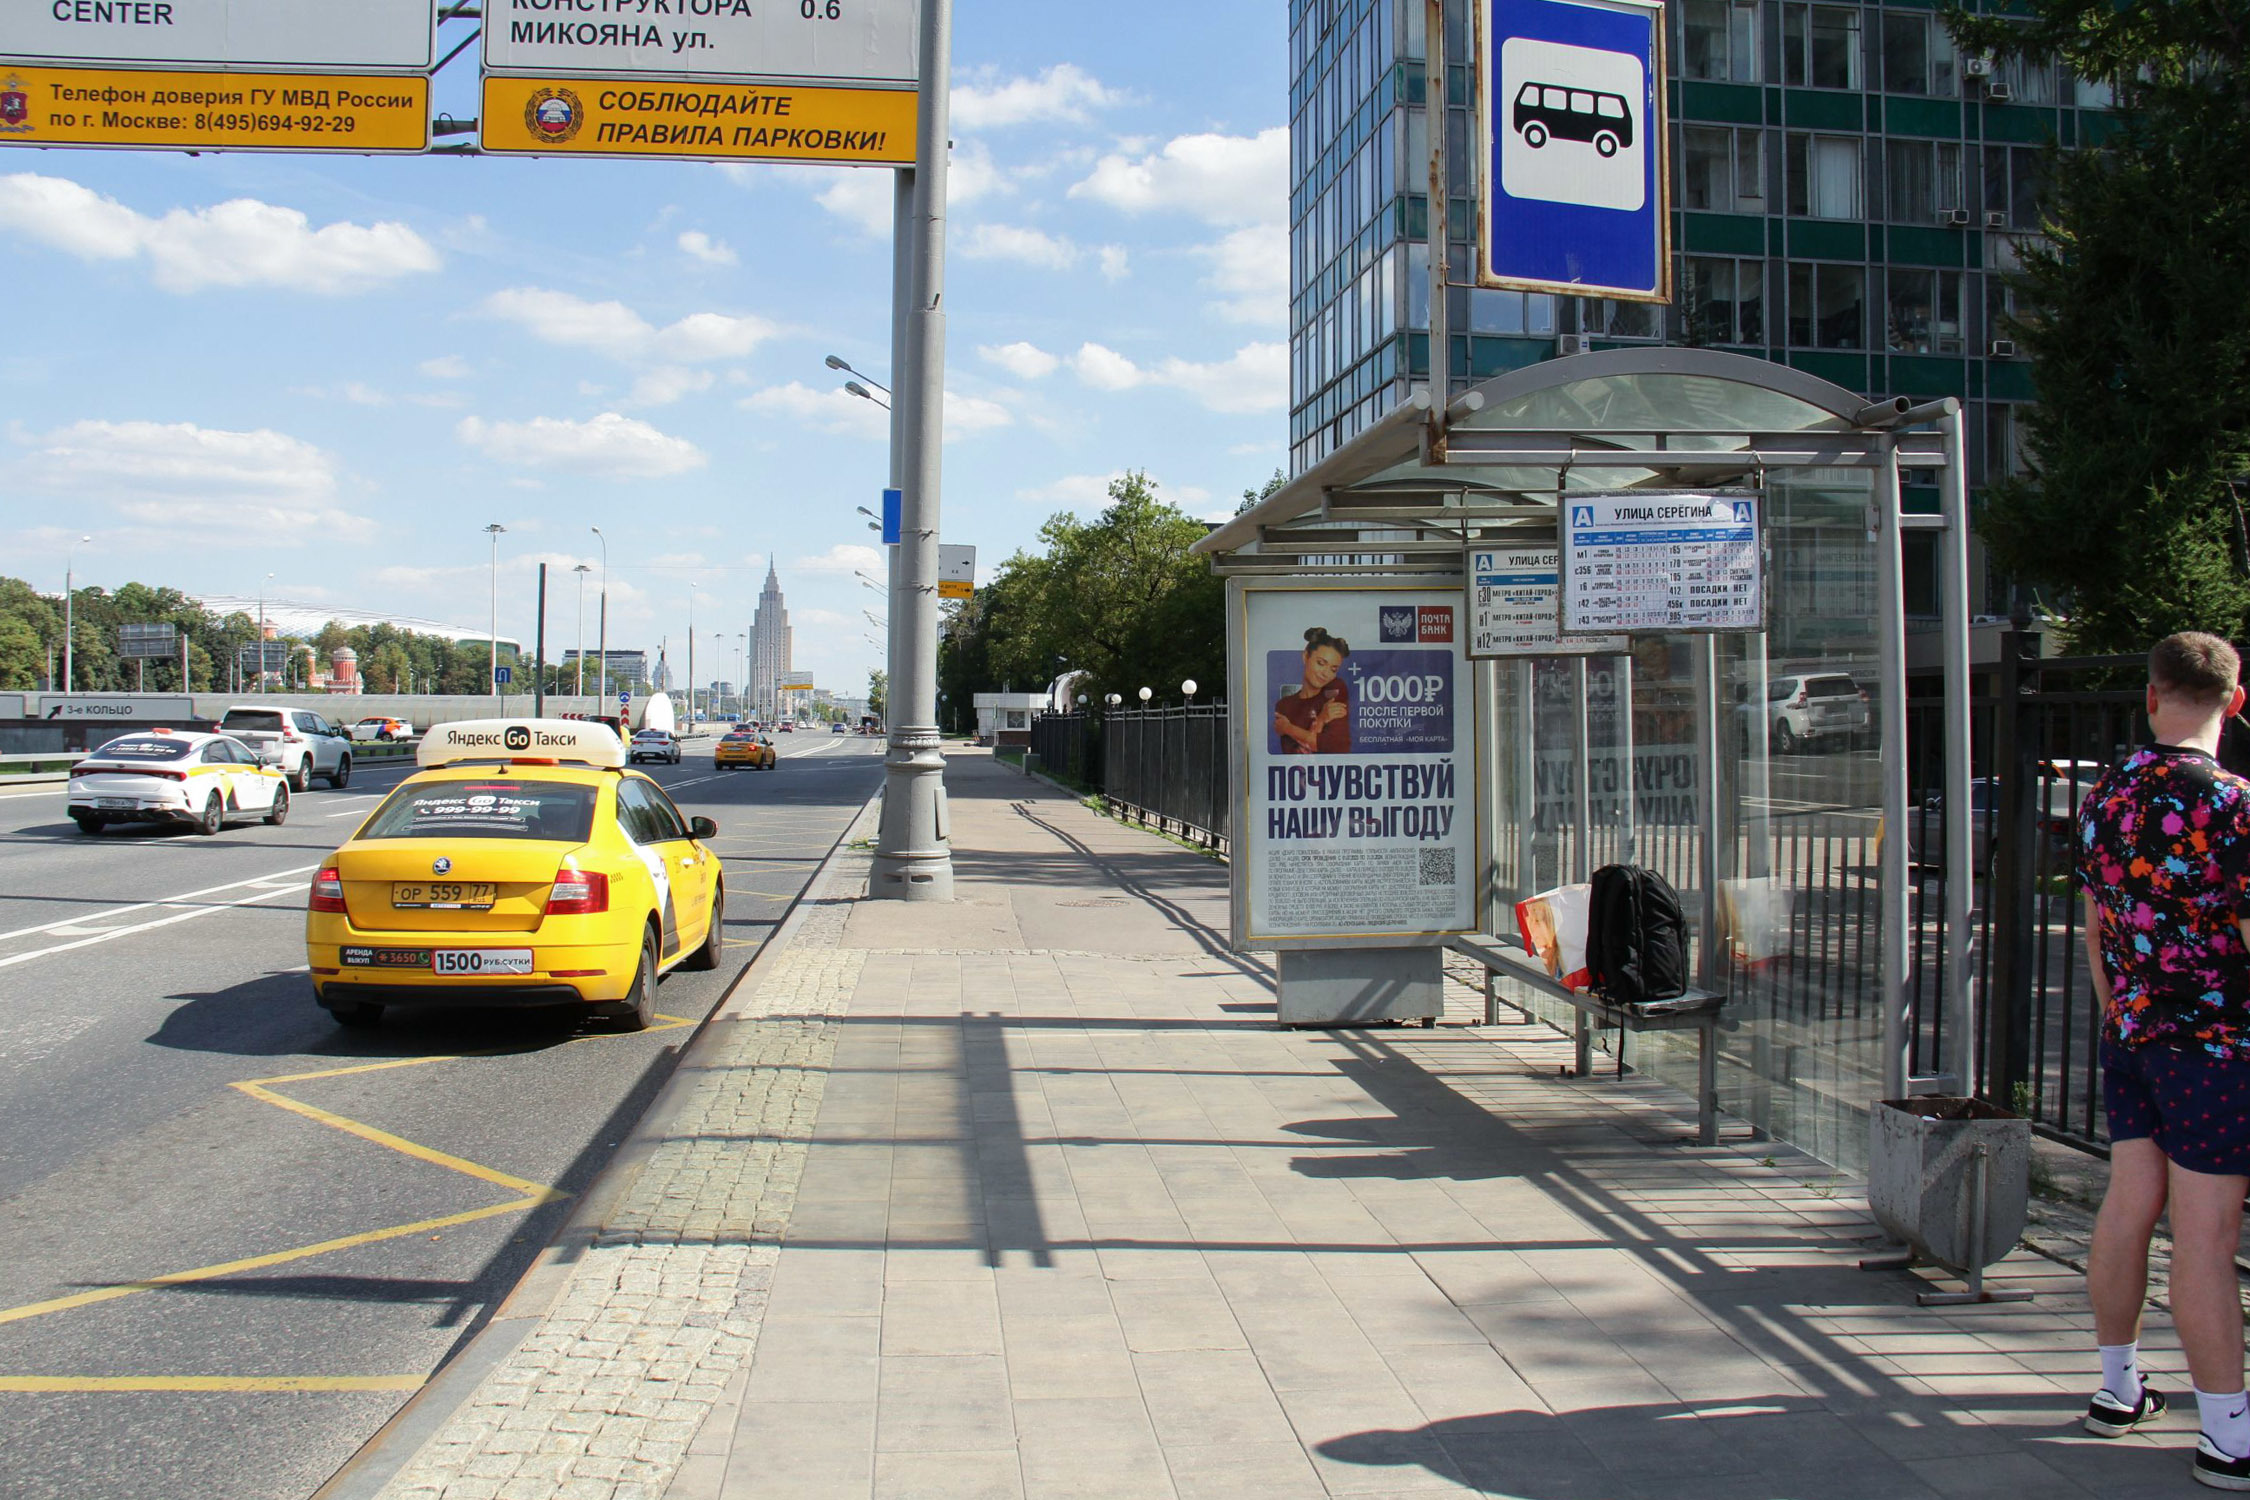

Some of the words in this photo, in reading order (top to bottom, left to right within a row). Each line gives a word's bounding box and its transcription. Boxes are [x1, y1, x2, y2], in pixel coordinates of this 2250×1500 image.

[53, 0, 174, 25] CENTER
[800, 0, 841, 20] 0.6
[511, 21, 663, 47] МИКОЯНА
[672, 32, 714, 53] ул.
[50, 84, 146, 105] Телефон
[152, 89, 243, 106] доверия
[250, 89, 275, 107] ГУ
[282, 90, 330, 109] МВД
[337, 91, 413, 108] России
[599, 90, 792, 118] СОБЛЮДАЙТЕ
[50, 114, 76, 127] по
[83, 114, 95, 128] г.
[102, 112, 188, 130] Москве:
[194, 113, 356, 133] 8(495)694-92-29
[597, 123, 723, 146] ПРАВИЛА
[731, 126, 886, 152] ПАРКОВКИ!
[1615, 508, 1654, 521] УЛИЦА
[1657, 504, 1713, 519] СЕРЁГИНА
[1509, 556, 1540, 566] УЛИЦА
[1669, 586, 1681, 595] 412
[1690, 585, 1728, 595] ПОСАДКИ
[1733, 584, 1747, 593] НЕТ
[1690, 598, 1728, 608] ПОСАДКИ
[1733, 597, 1747, 606] НЕТ
[1421, 614, 1450, 624] ПОЧТА
[1421, 625, 1447, 635] БАНК
[1493, 635, 1511, 643] МЕТРО
[67, 705, 83, 715] 3-е
[86, 705, 133, 716] КОЛЬЦО
[1359, 706, 1398, 717] ПОСЛЕ
[1400, 704, 1444, 717] ПЕРВОЙ
[1359, 718, 1412, 729] ПОКУПКИ
[447, 731, 501, 747] Яндекс
[507, 731, 528, 746] Go
[534, 731, 577, 746] Такси
[1268, 758, 1455, 801] ПОЧУВСТВУЙ
[498, 797, 540, 806] Такси
[433, 806, 521, 814] 999-99-99
[1268, 807, 1343, 840] НАШУ
[1349, 805, 1455, 841] ВЫГОДУ
[401, 888, 422, 900] ОР
[430, 885, 462, 901] 559
[472, 884, 489, 897] 77
[437, 953, 482, 970] 1500
